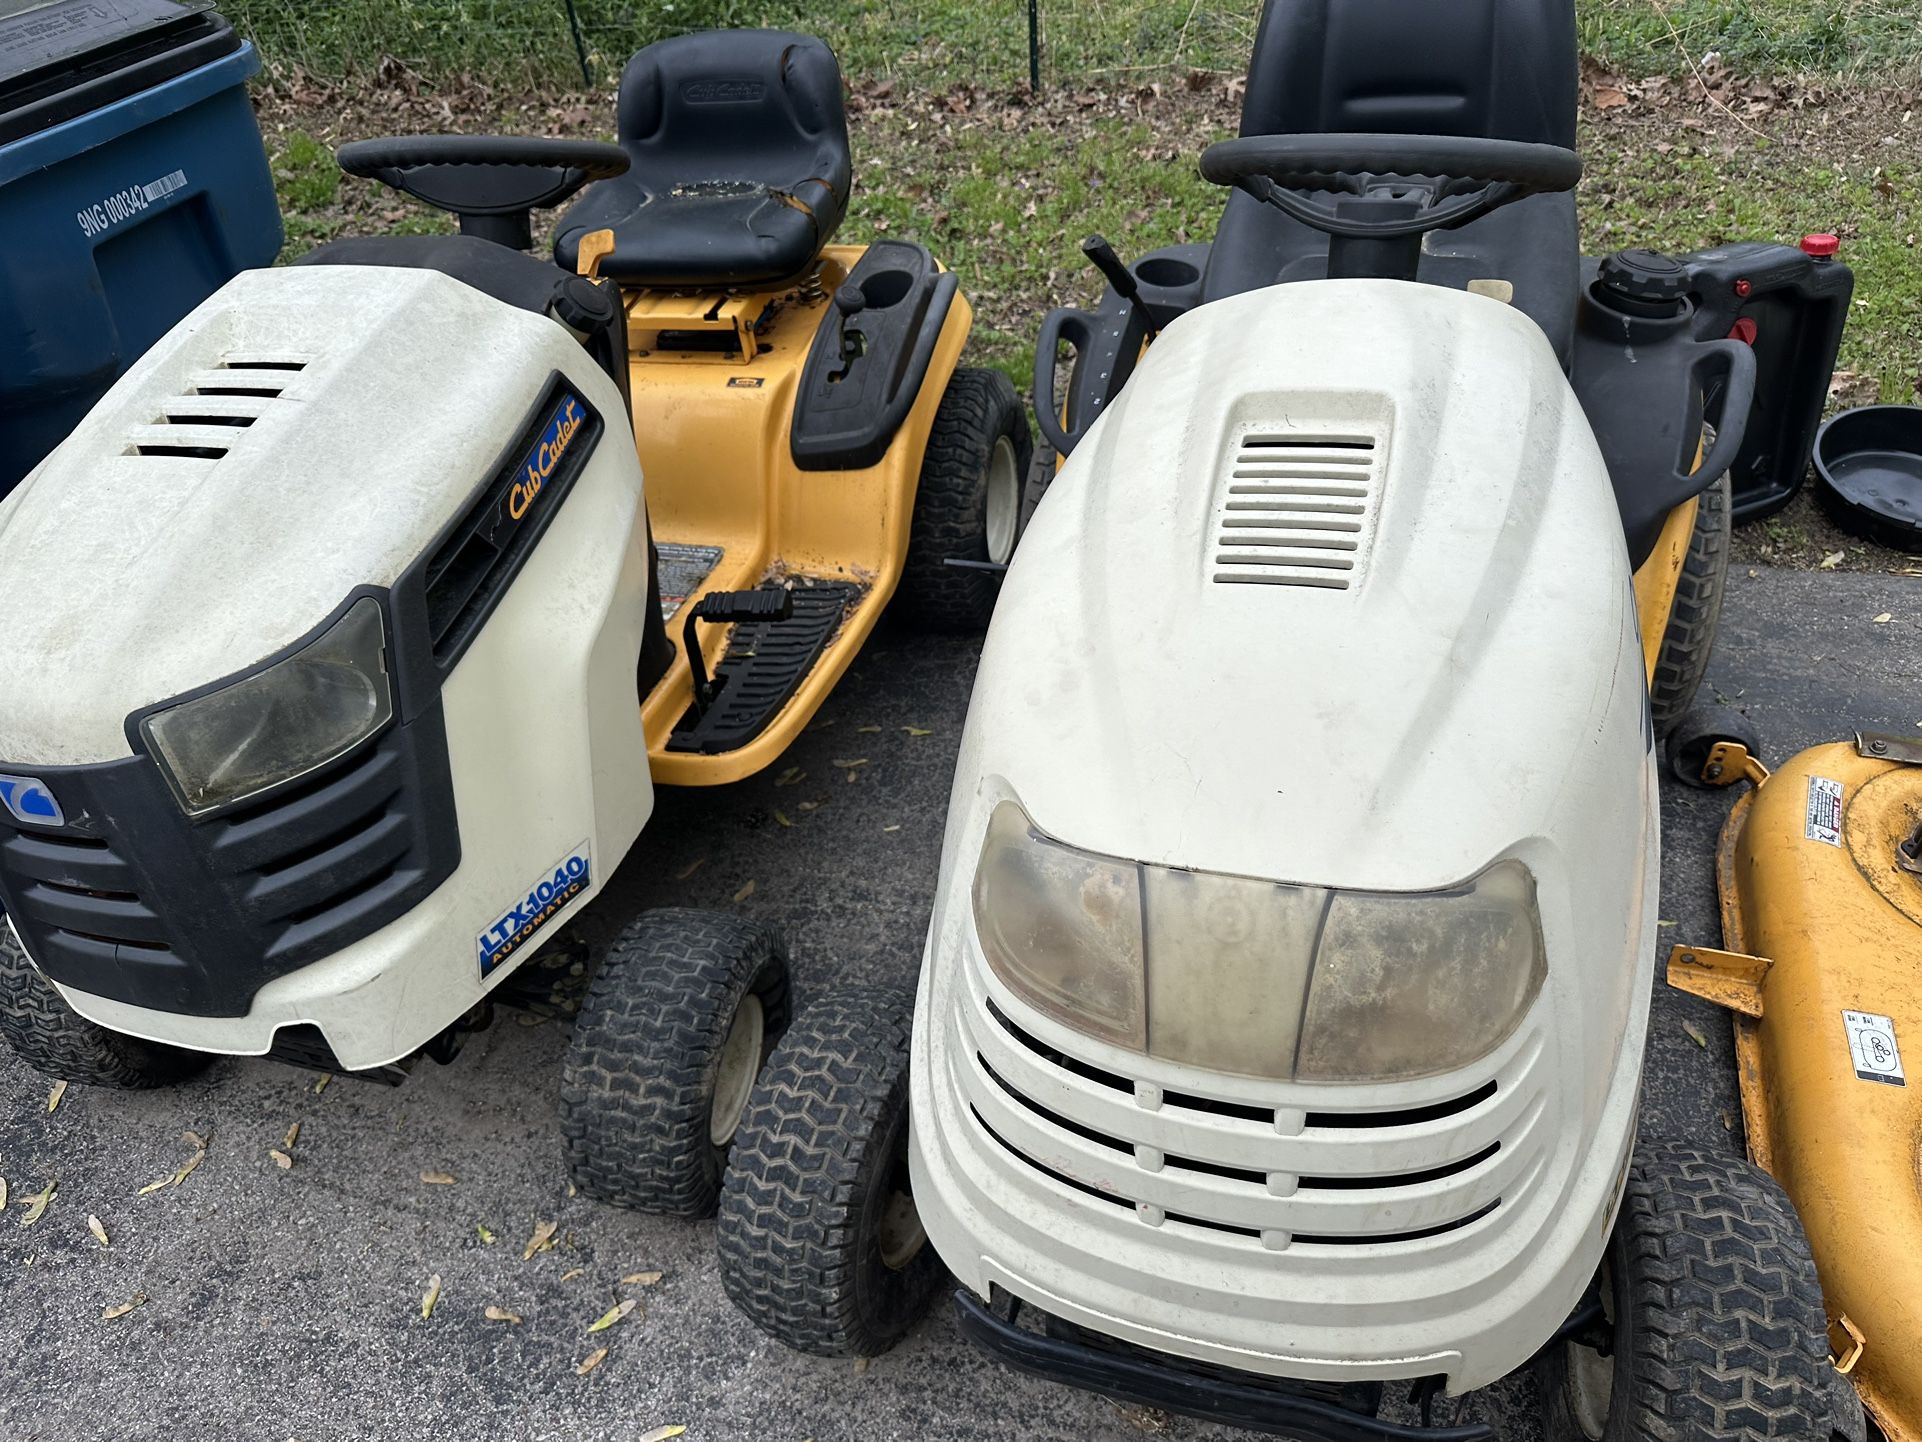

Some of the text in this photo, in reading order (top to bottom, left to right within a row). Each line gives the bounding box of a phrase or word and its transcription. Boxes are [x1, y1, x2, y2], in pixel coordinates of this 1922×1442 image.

[77, 184, 149, 238] 9NG 000342
[509, 400, 580, 520] Cub Cadet
[492, 882, 580, 964] AUTOMATIC
